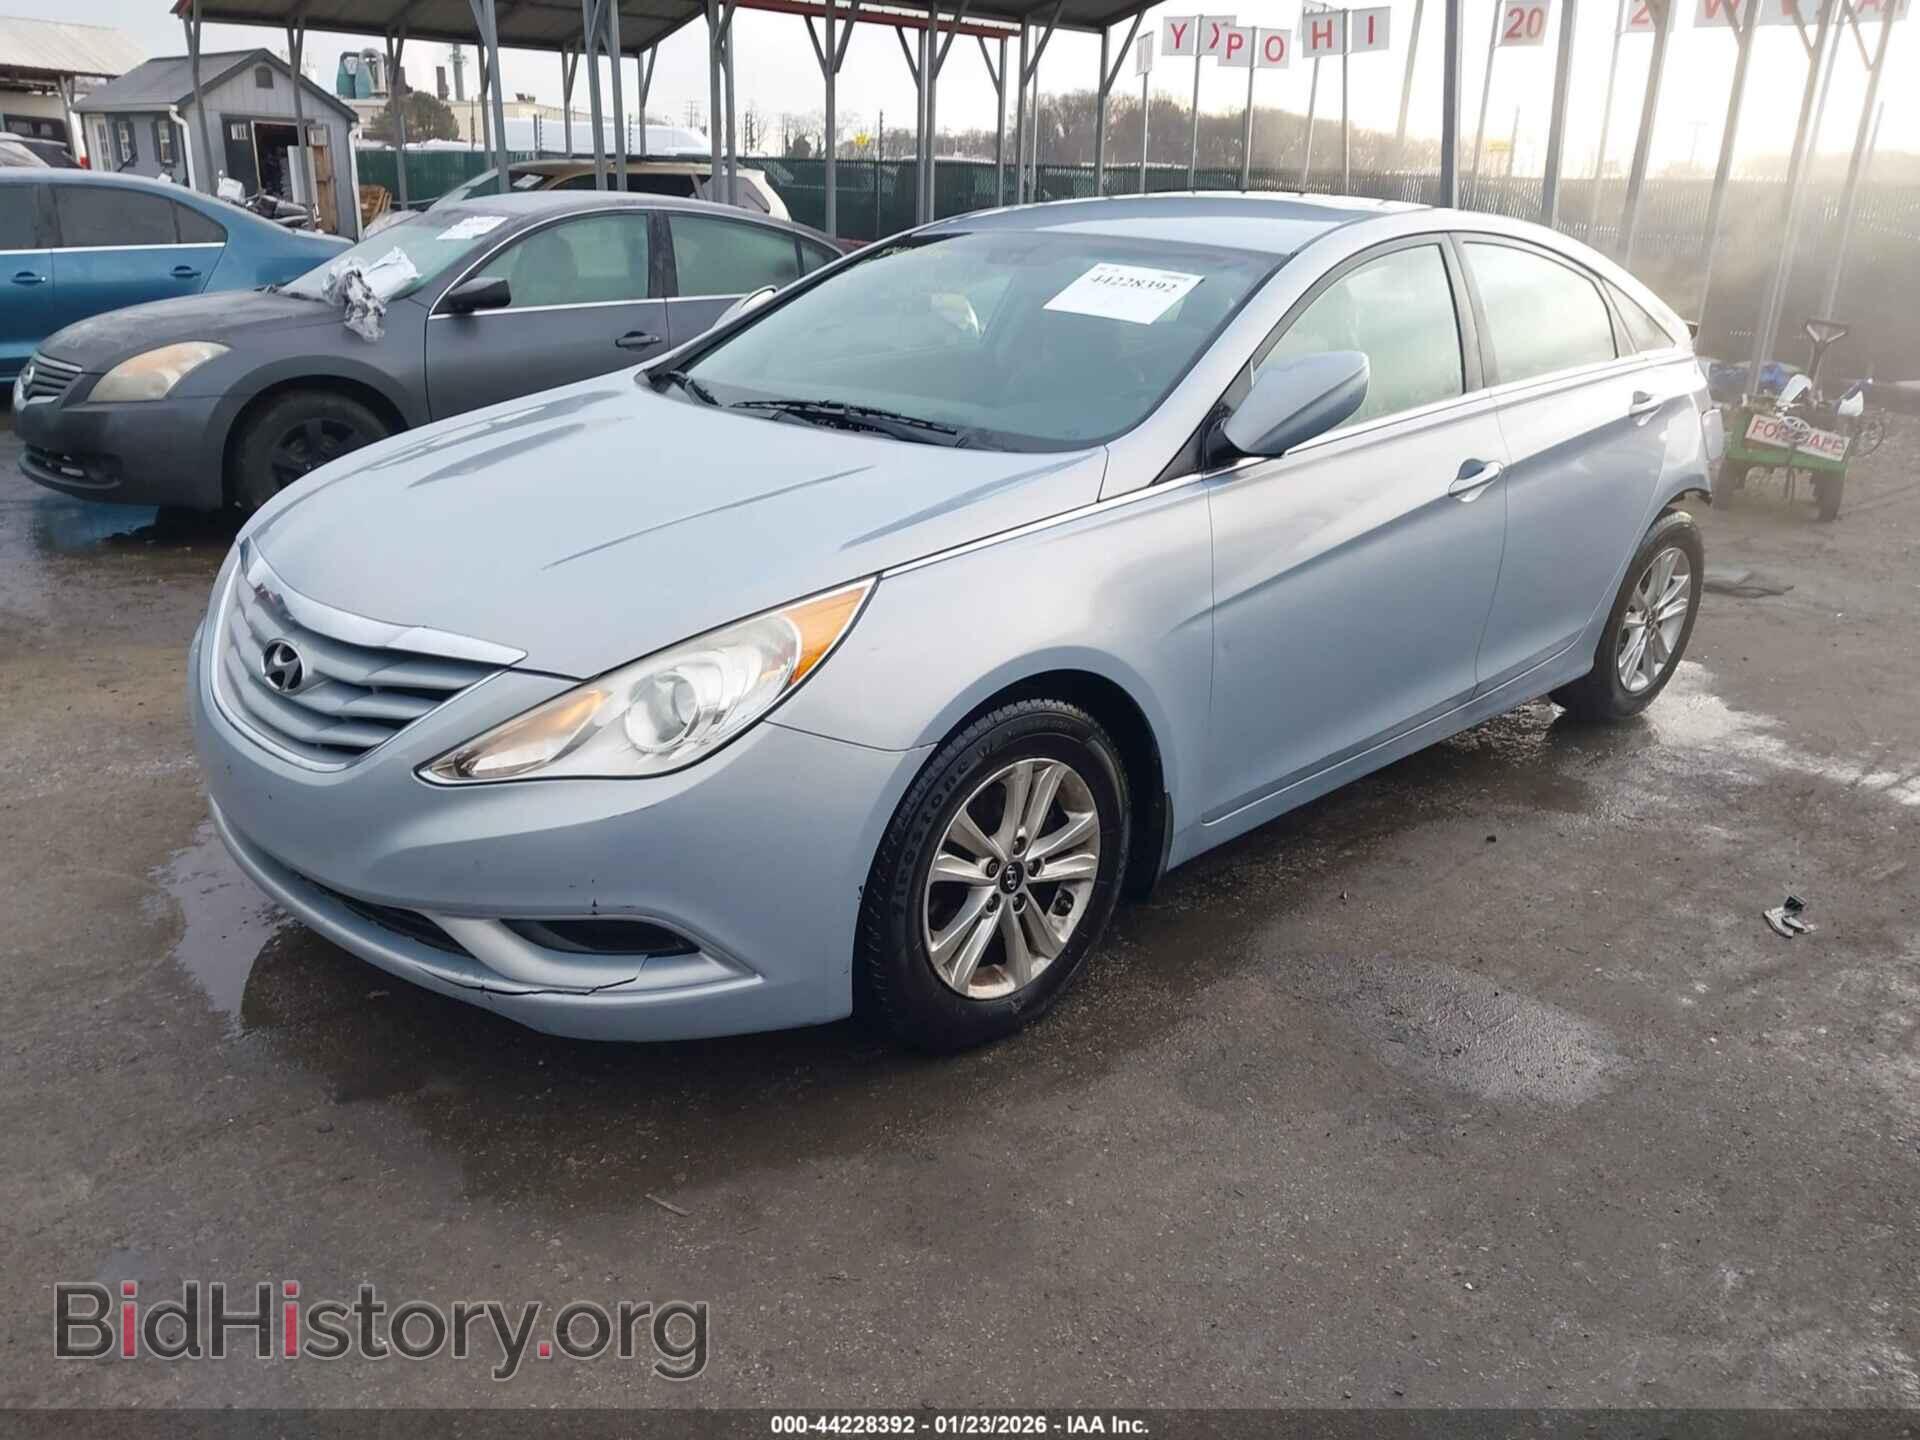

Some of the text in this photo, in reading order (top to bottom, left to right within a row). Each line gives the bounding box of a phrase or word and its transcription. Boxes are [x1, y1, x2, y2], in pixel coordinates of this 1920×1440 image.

[1170, 23, 1188, 49] Y
[1312, 19, 1332, 50] H
[1504, 7, 1545, 38] 20
[1226, 33, 1244, 60] P
